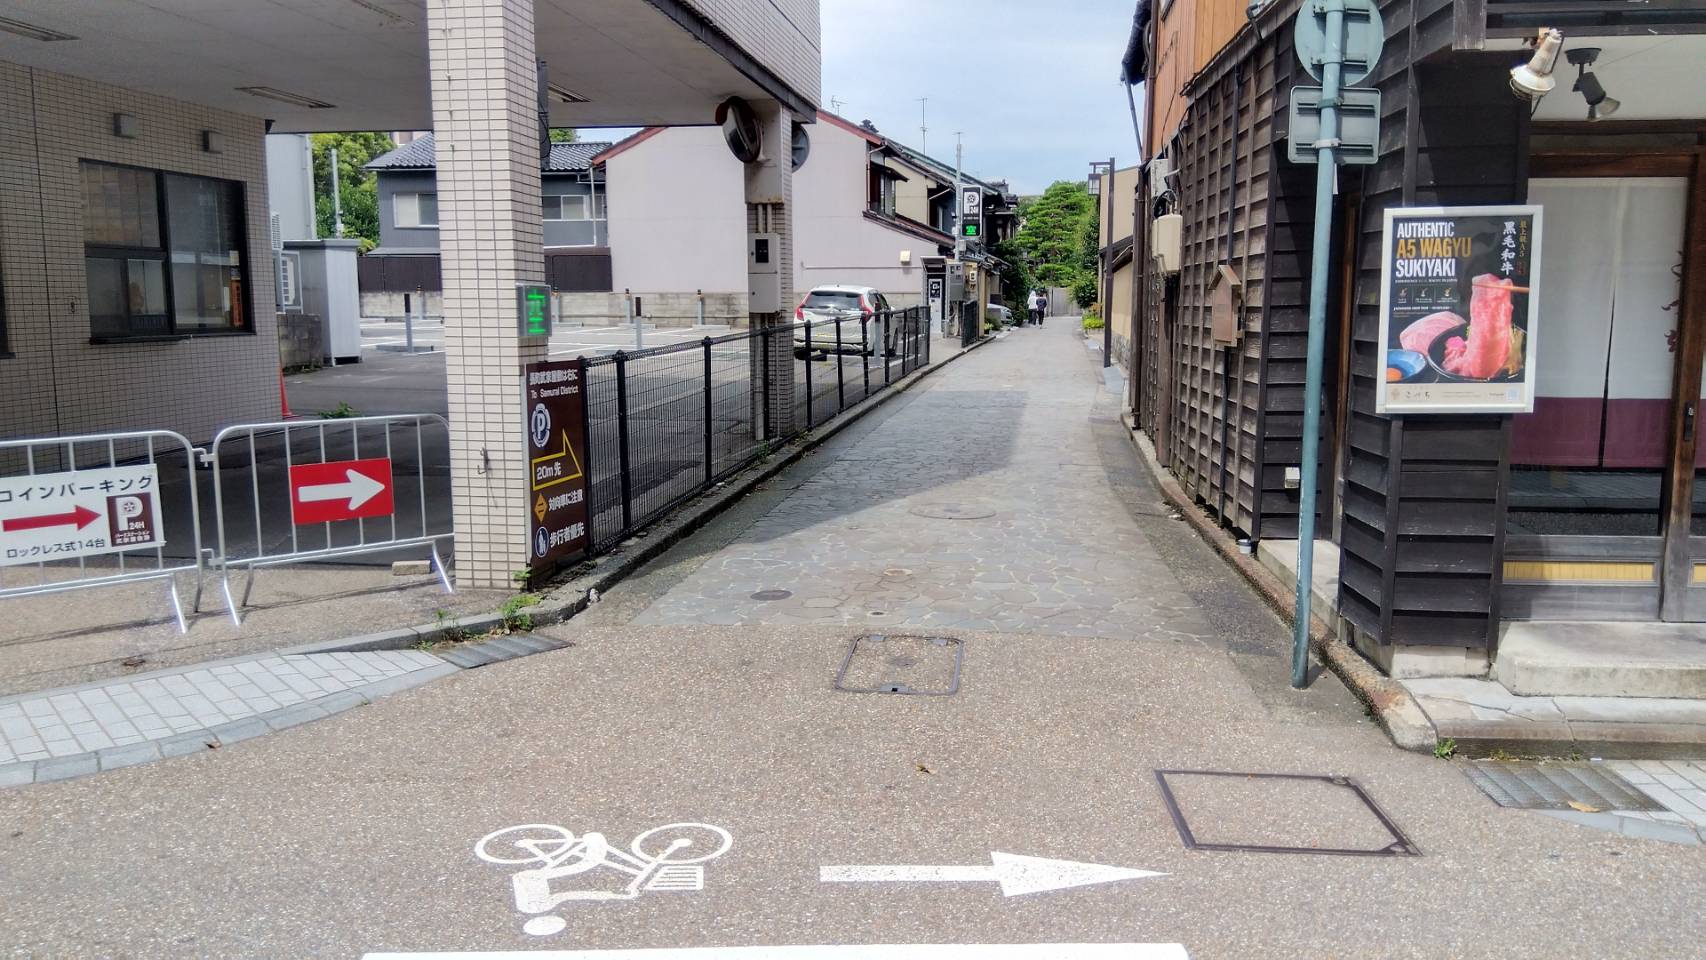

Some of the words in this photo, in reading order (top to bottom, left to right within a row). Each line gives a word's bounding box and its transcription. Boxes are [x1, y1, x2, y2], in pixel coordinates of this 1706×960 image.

[1396, 221, 1455, 238] AUTHENTIC
[1396, 238, 1417, 259] A5
[1419, 237, 1472, 258] WAGYU
[1500, 221, 1517, 276] 黒毛和牛
[1395, 258, 1456, 278] SUKIYAKI
[530, 389, 538, 399] To
[540, 386, 560, 398] Samurai
[560, 384, 579, 395] District
[115, 496, 144, 531] P
[128, 521, 145, 530] 24H
[549, 521, 585, 548] 歩行者優先
[7, 538, 106, 558] ロックレス式14台
